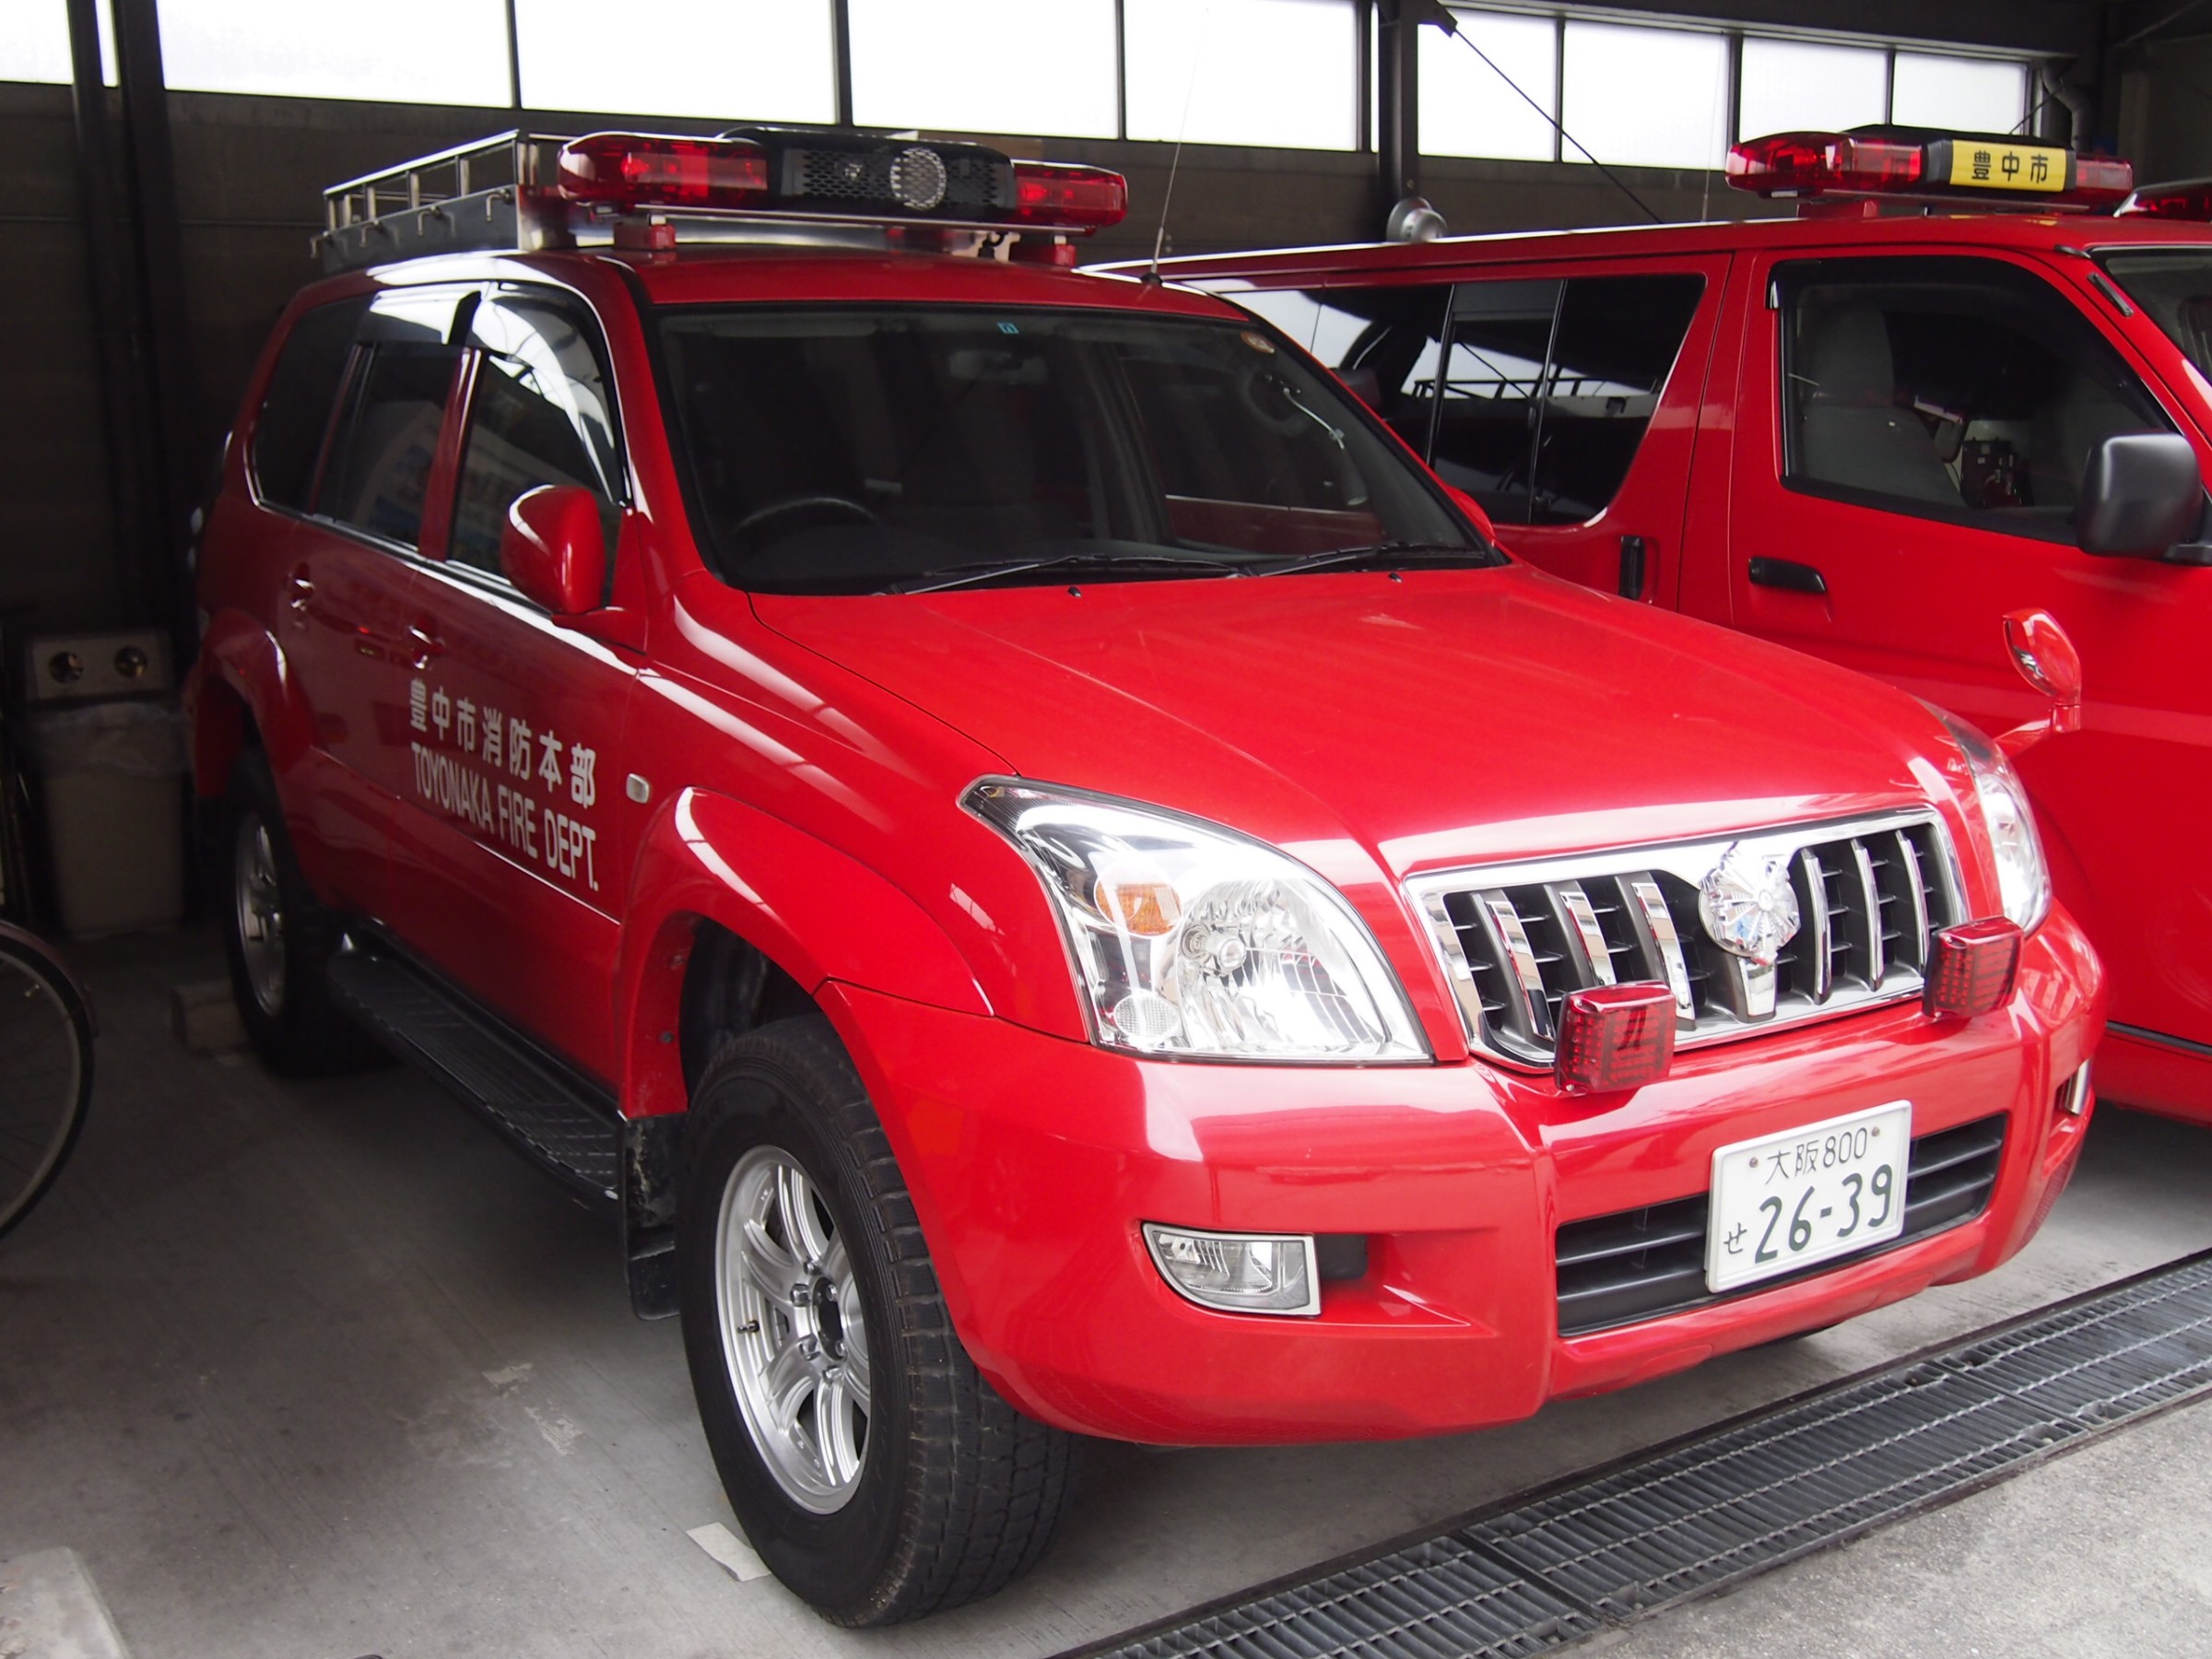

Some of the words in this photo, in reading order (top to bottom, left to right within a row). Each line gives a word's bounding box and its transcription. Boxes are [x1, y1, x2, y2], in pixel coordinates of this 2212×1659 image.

[1971, 150, 2049, 183] 豊中市
[410, 678, 596, 809] 豊中市消防本部
[411, 741, 495, 834] TOYONAKA
[498, 784, 538, 859] FIRE
[544, 808, 599, 891] DEPT.
[1724, 1222, 1747, 1254] せ
[1755, 1164, 1893, 1264] 26-39
